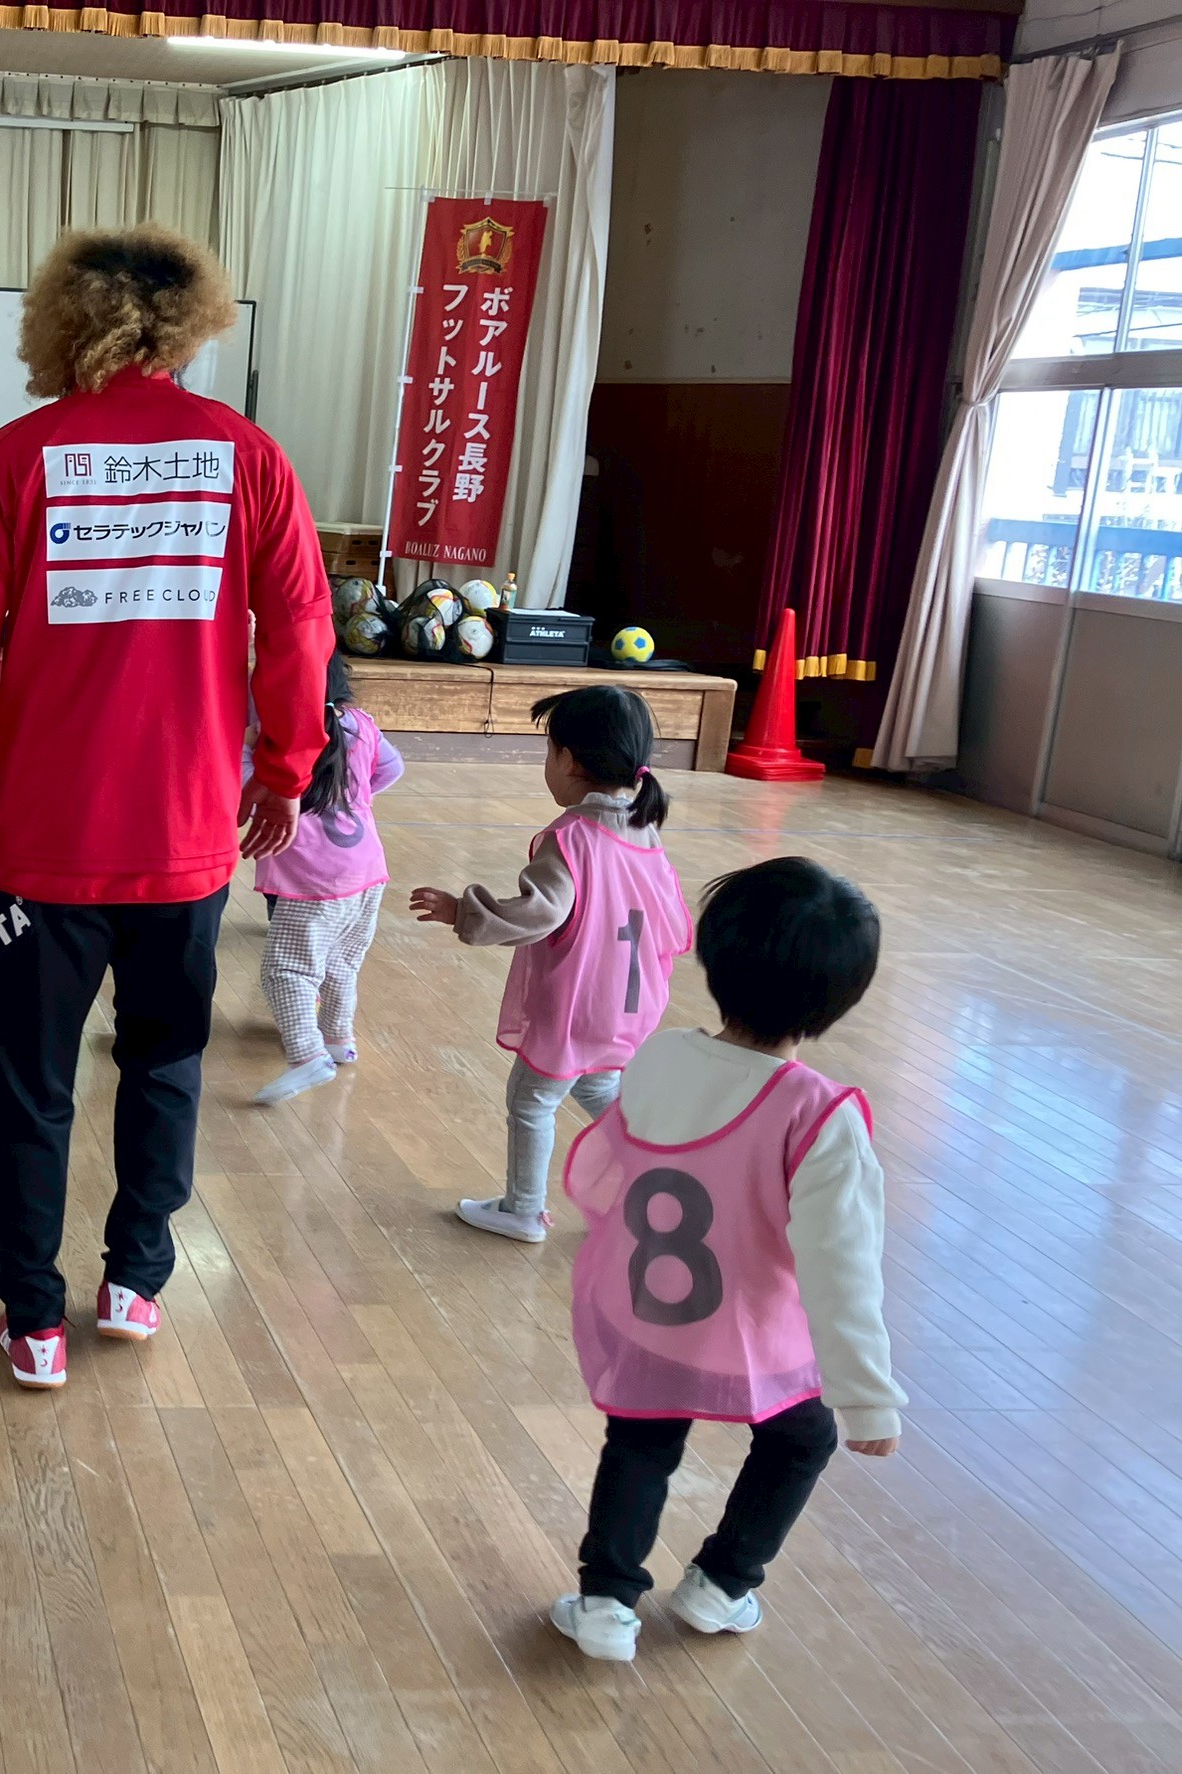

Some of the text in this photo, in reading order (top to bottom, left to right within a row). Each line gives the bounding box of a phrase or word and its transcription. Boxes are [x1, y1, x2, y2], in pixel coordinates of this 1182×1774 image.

[416, 283, 470, 526] フットサルクラブ
[452, 286, 513, 503] ボアルース長野
[104, 451, 220, 483] 鈴木土地
[73, 521, 226, 541] セラテックジャパン
[405, 541, 487, 562] BOALUZ NAGANO
[105, 589, 155, 604] FREE
[617, 908, 645, 1014] 1
[623, 1167, 723, 1326] 8
